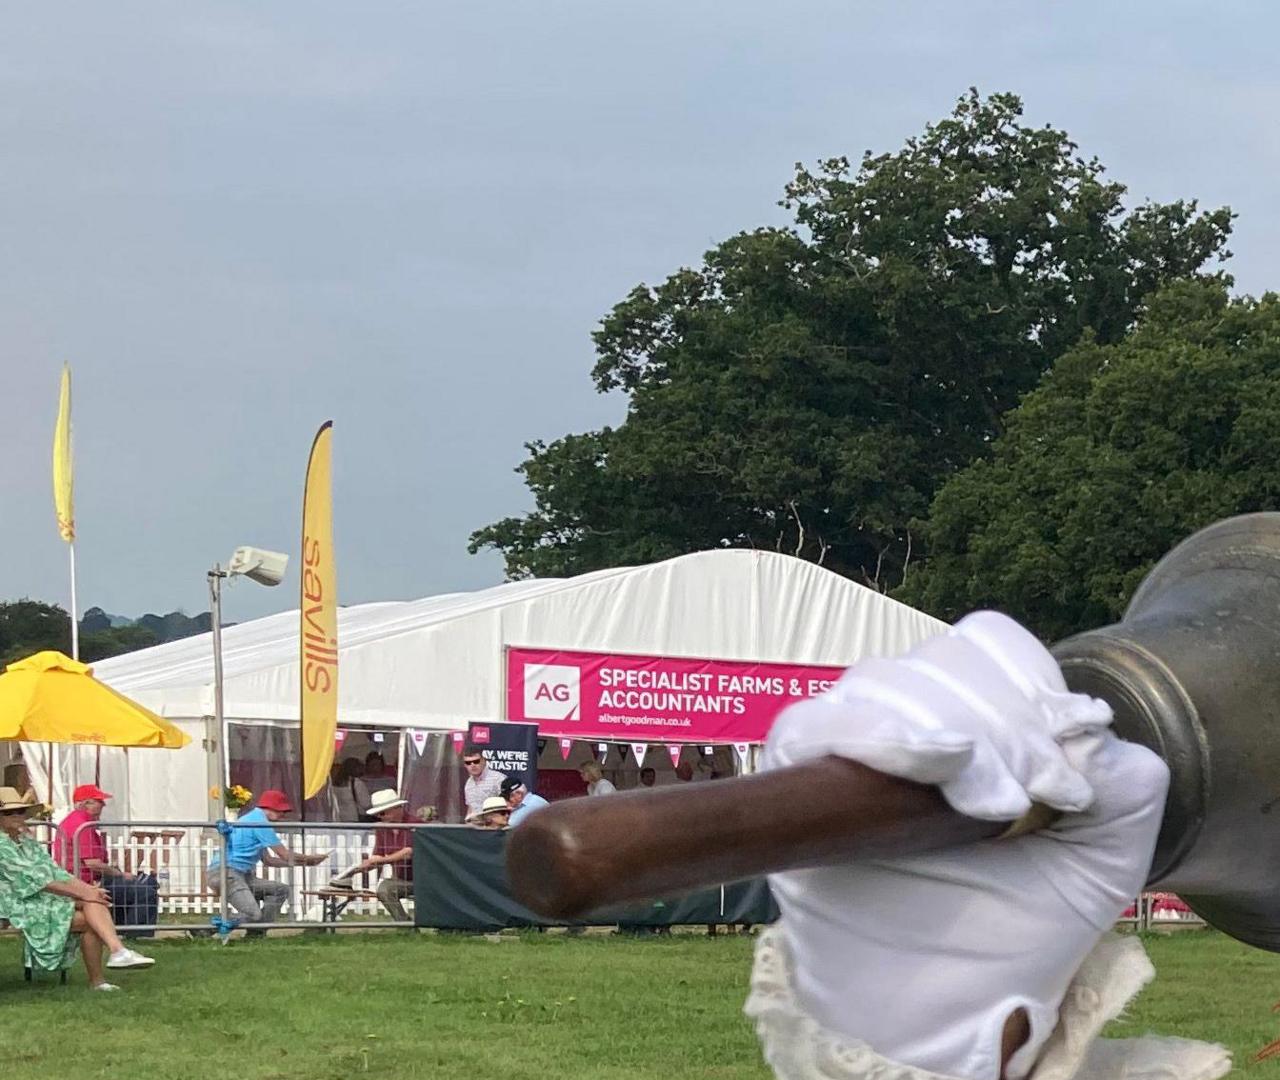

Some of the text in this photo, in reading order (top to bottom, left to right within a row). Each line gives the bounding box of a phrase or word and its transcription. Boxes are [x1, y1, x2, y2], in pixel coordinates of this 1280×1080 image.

[303, 536, 338, 693] savills
[534, 682, 570, 702] AG
[599, 668, 713, 692] SPECIALIST
[717, 675, 785, 696] FARMS
[788, 678, 803, 696] &
[598, 690, 746, 714] ACCOUNTANTS
[598, 713, 692, 728] albertgoodman.co.uk
[481, 749, 529, 761] AY, WE'RE
[486, 760, 528, 771] NTASTIC
